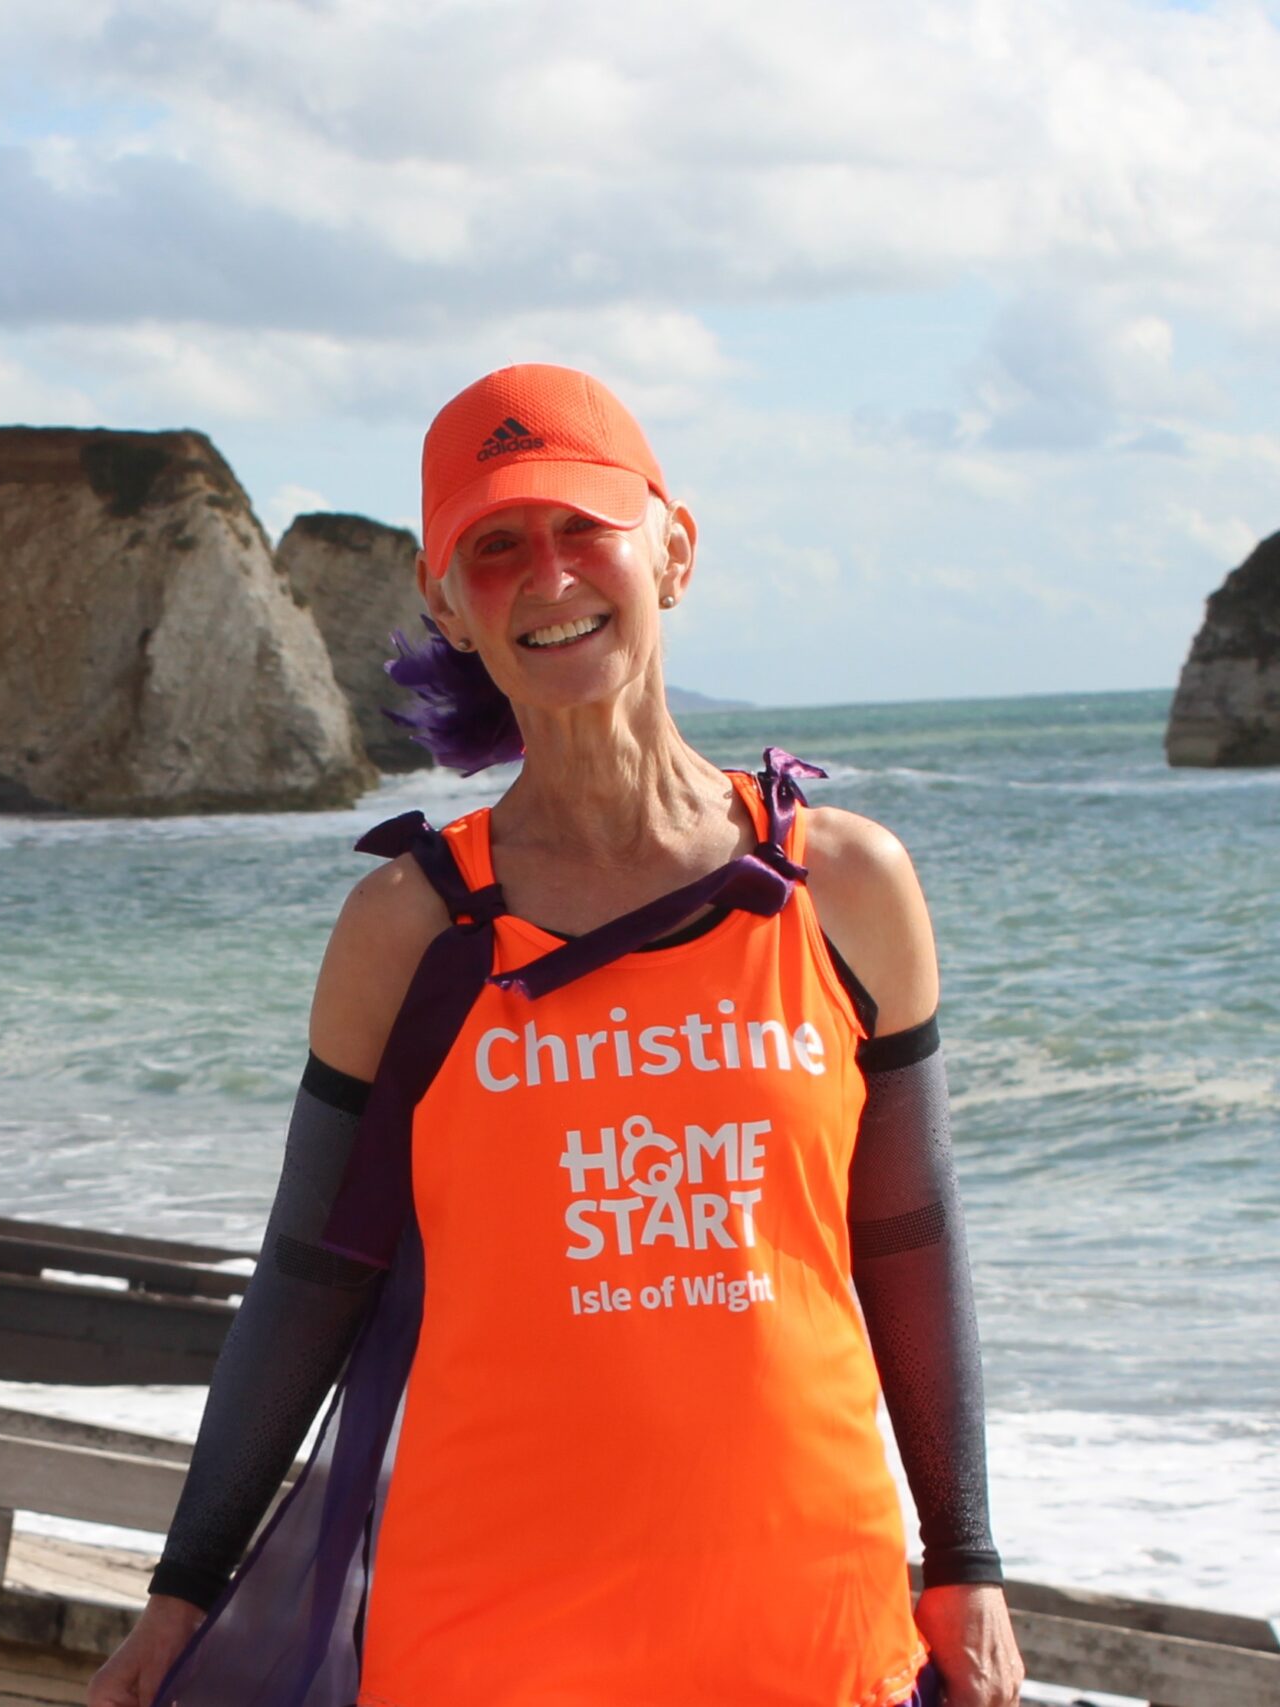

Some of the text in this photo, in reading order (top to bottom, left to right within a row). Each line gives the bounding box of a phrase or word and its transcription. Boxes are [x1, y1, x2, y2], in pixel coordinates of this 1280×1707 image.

[476, 437, 544, 462] adidas
[475, 999, 827, 1092] Christine
[559, 1115, 772, 1197] HOME
[564, 1188, 762, 1260] START
[570, 1270, 776, 1315] Isle of Wight
